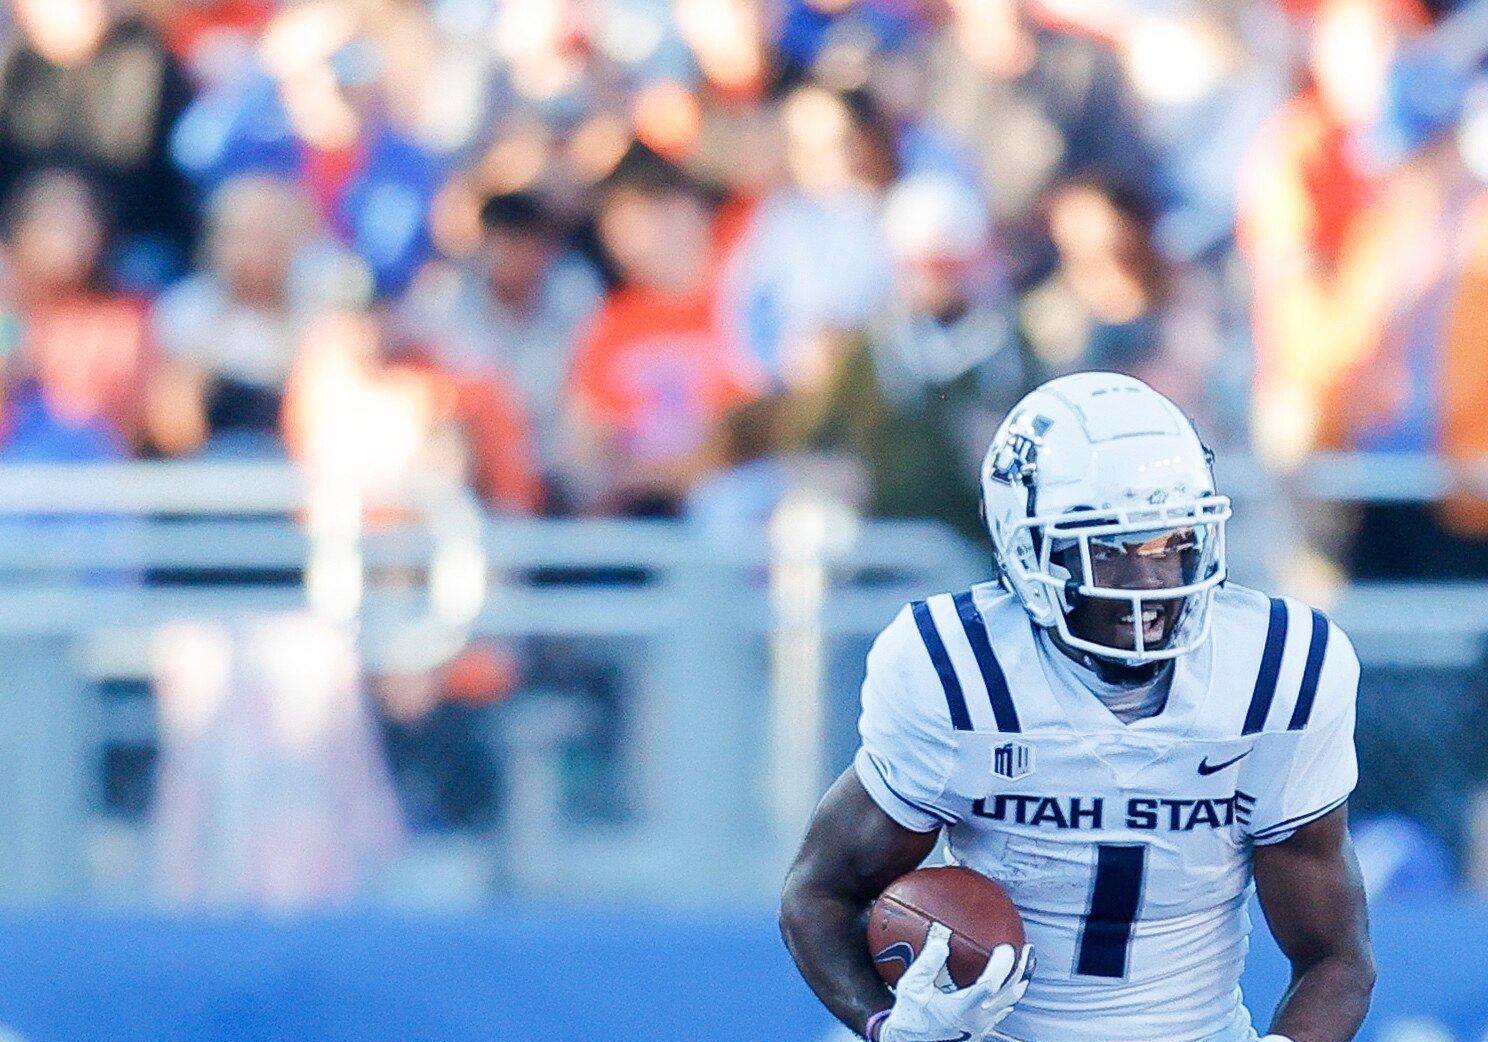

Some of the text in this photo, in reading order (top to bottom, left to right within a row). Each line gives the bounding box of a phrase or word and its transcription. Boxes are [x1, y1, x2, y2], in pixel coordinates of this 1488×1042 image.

[973, 790, 1257, 831] UTAH STATE
[1071, 843, 1149, 983] 1
